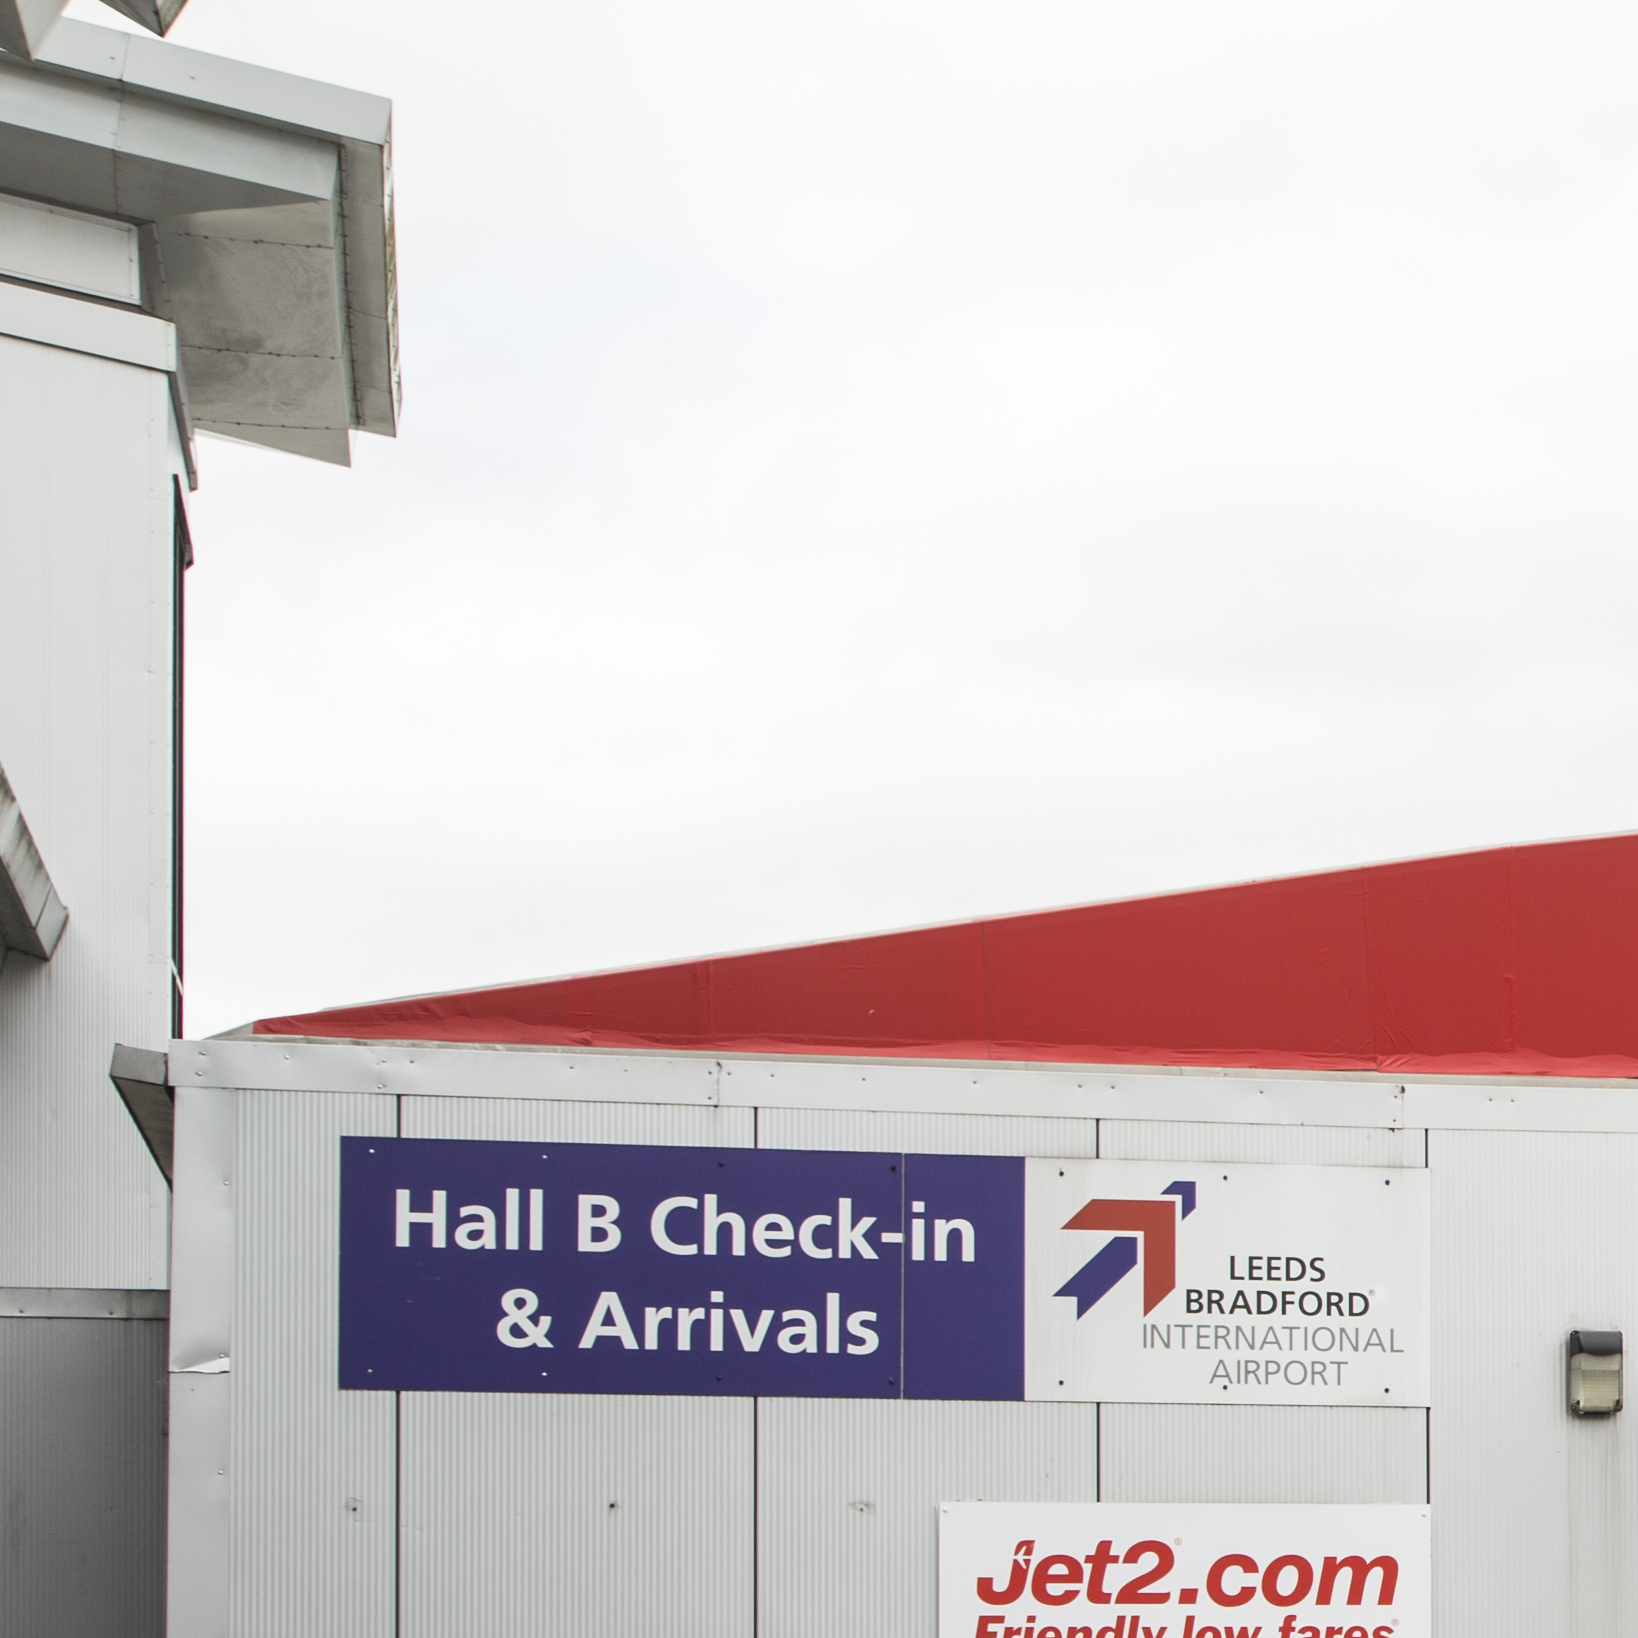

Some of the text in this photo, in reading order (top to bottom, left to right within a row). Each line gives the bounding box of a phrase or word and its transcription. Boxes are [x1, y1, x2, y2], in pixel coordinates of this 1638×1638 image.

[394, 1189, 976, 1263] Hall B Check-in
[1227, 1256, 1326, 1284] LEEDS
[1185, 1288, 1370, 1317] BRADFORD
[496, 1288, 879, 1355] & Arrivals
[1141, 1322, 1404, 1354] INTERNATIONAL
[1209, 1358, 1348, 1387] AIRPORT
[976, 1538, 1399, 1607] Jet2.com
